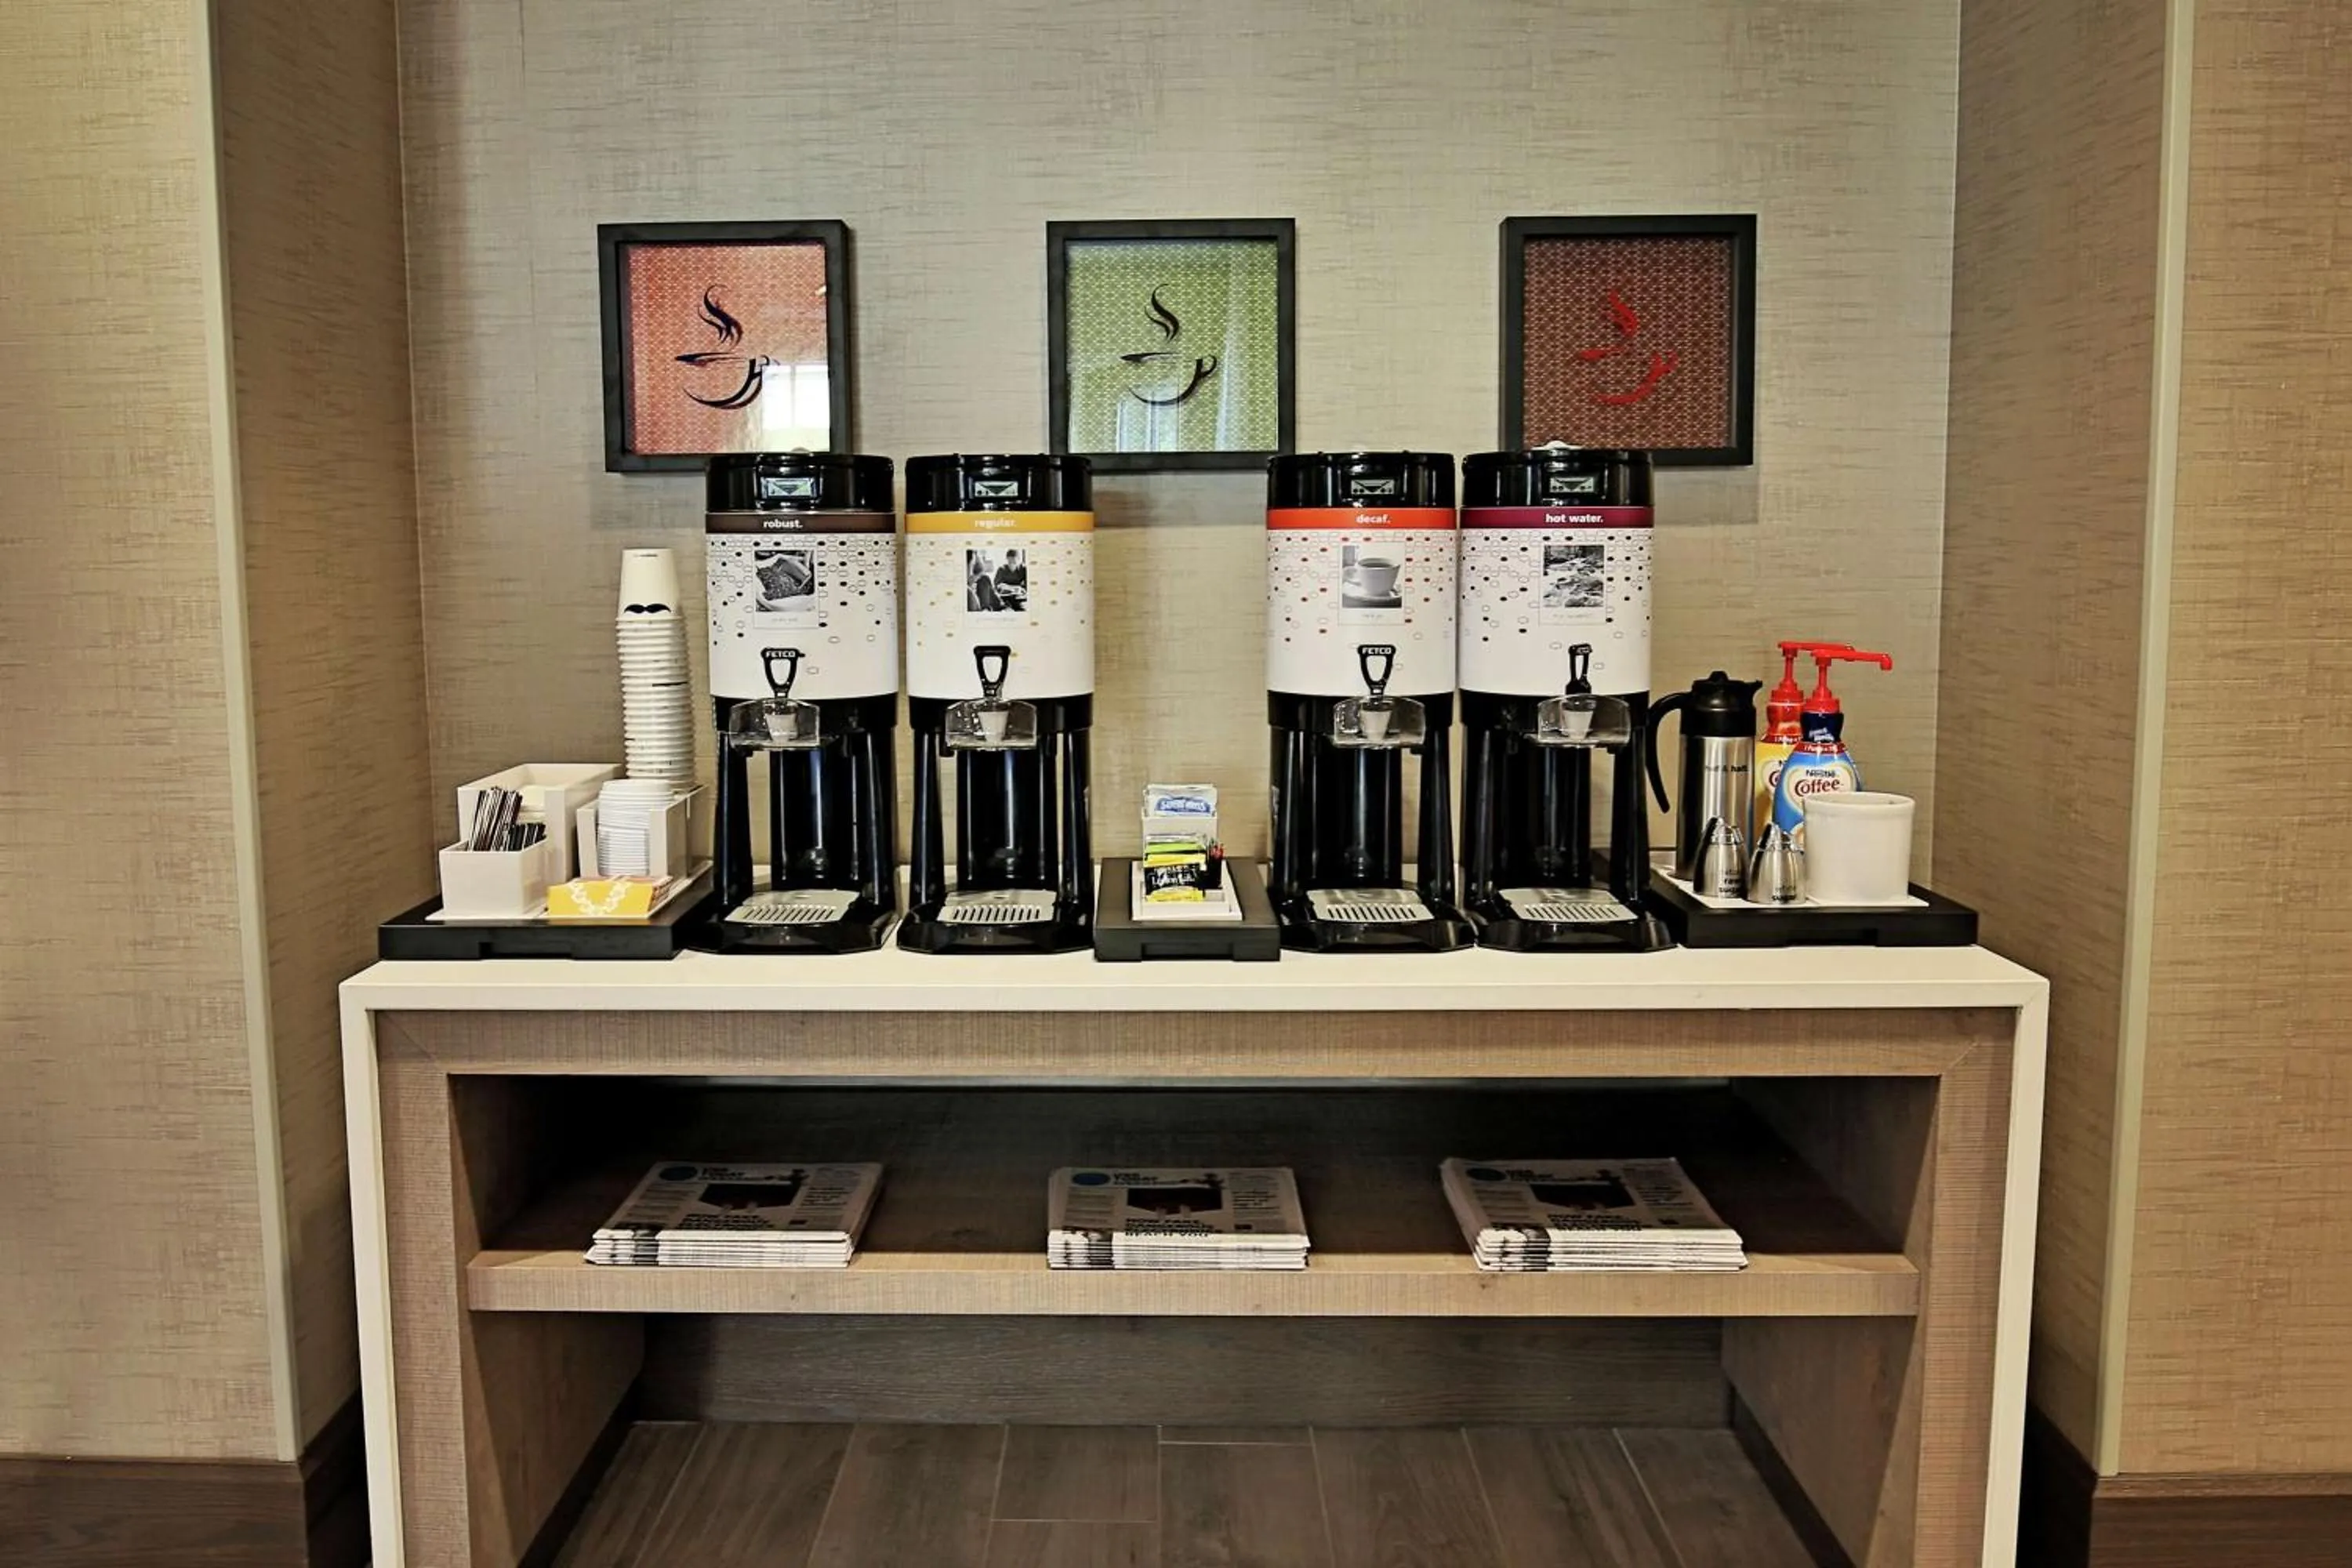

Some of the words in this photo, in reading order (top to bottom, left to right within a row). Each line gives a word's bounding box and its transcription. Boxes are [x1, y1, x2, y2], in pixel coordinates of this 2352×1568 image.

[763, 519, 803, 528] robust.
[975, 518, 1016, 529] regular.
[1356, 514, 1391, 524] decaf.
[1545, 514, 1566, 523] hot
[1569, 514, 1604, 523] water.
[1795, 779, 1840, 797] Coffee
